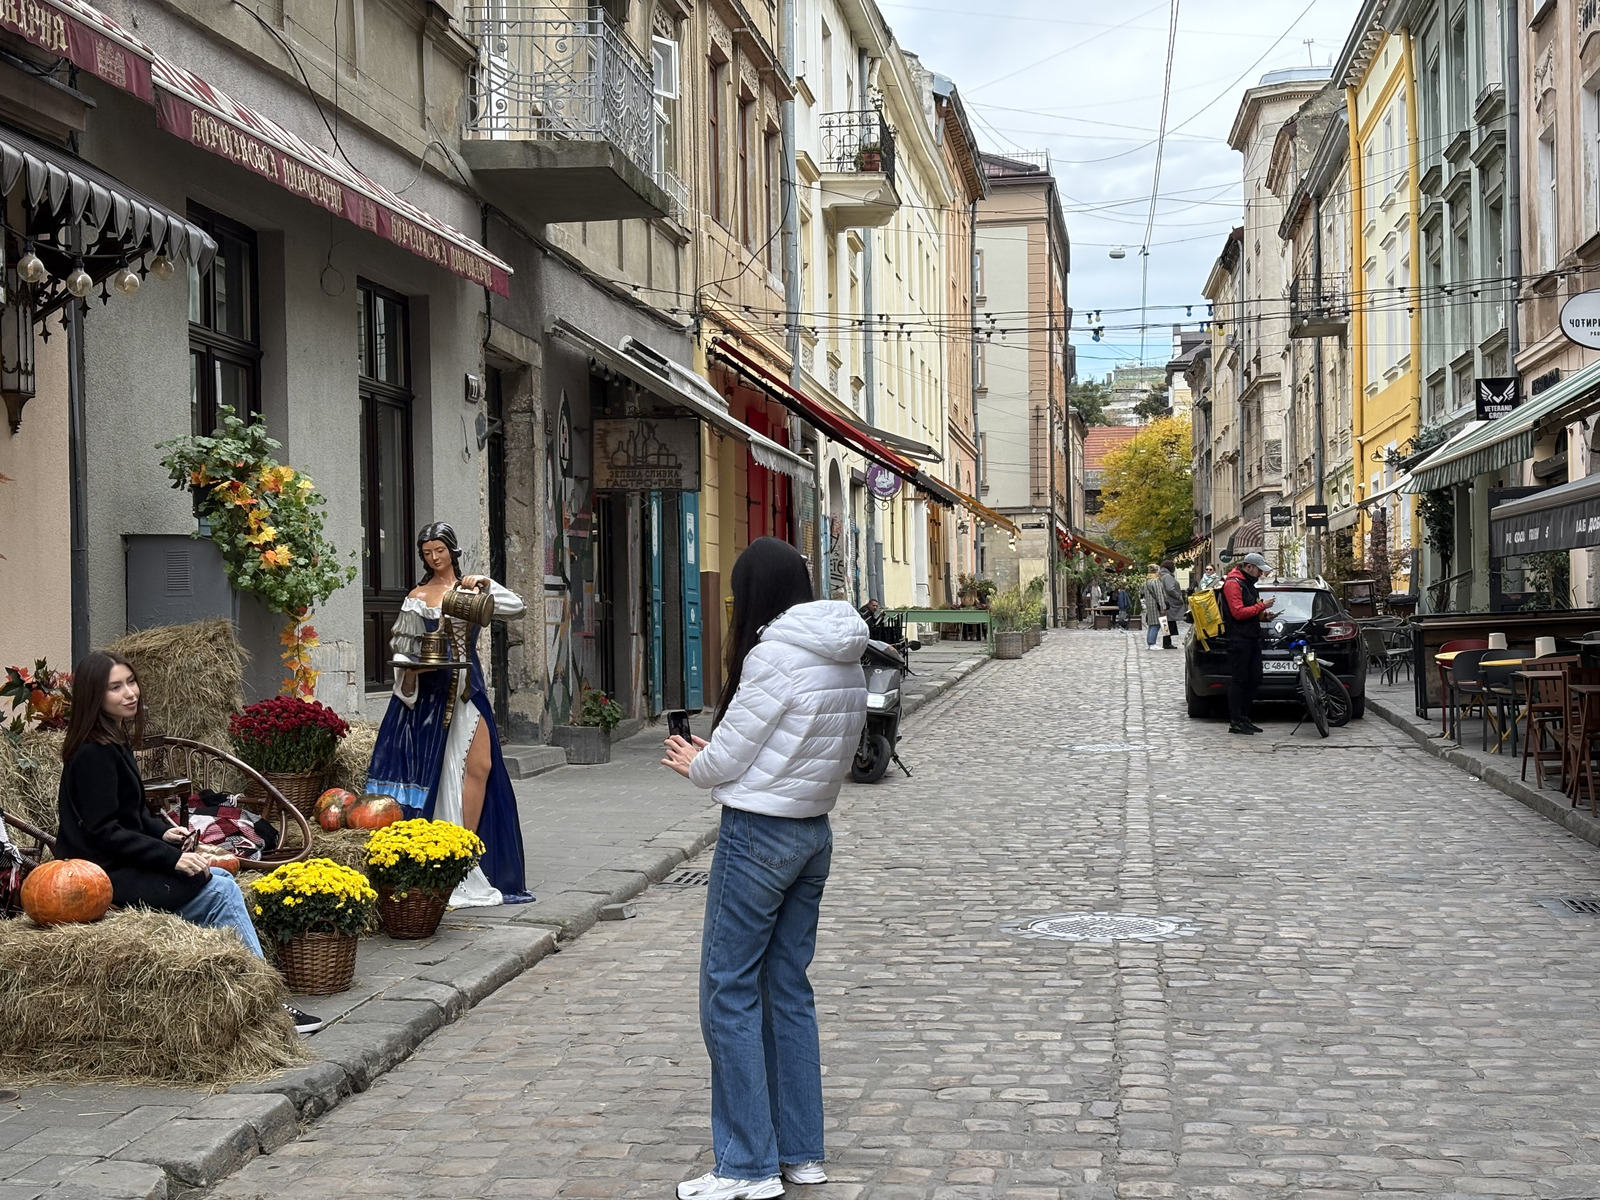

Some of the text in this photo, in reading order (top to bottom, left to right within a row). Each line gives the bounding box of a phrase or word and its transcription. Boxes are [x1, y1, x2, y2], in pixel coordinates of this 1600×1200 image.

[0, 0, 68, 51] ВАРНЯ
[609, 470, 680, 478] ЗЕЛЕНА СЛИВКА
[606, 479, 683, 487] ГАСТРО-ПАБ
[1272, 662, 1290, 670] 4841
